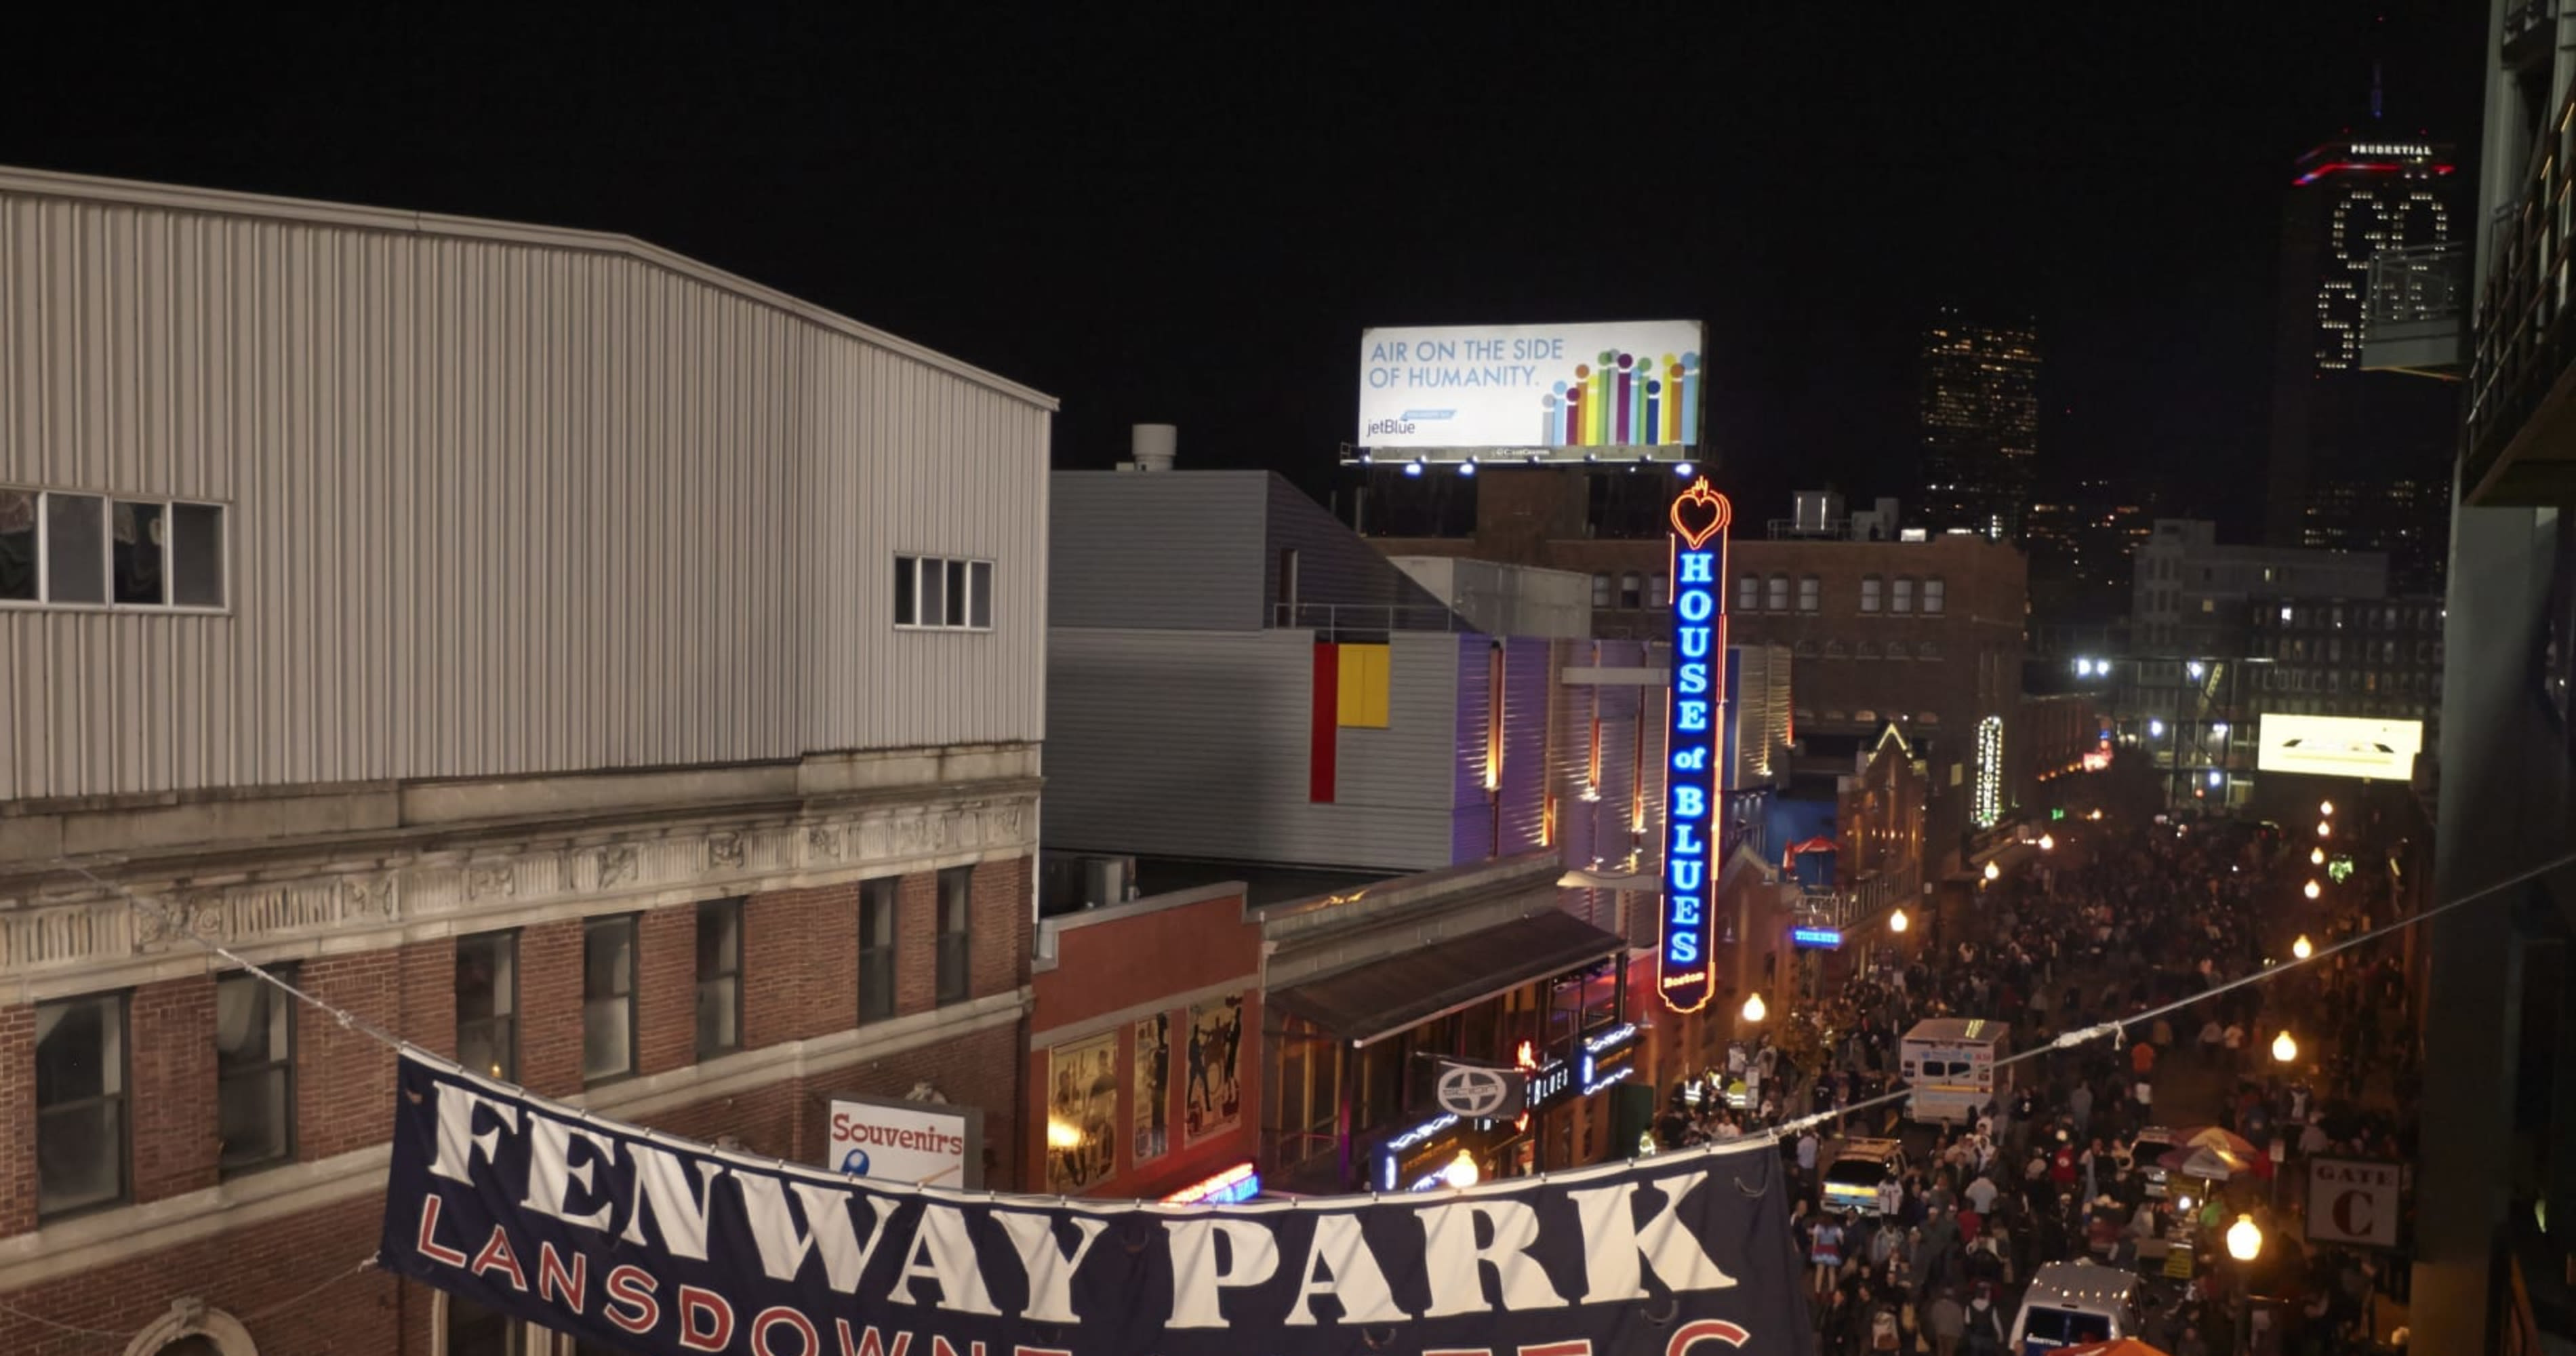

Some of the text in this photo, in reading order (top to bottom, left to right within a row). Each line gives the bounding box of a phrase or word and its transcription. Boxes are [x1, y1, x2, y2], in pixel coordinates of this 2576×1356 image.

[2350, 144, 2432, 155] PRUDENTIAL
[2332, 191, 2448, 270] GO
[1371, 338, 1563, 361] AIR ON THE SIDE
[1369, 365, 1539, 388] OF HUMANITY.
[1366, 418, 1415, 437] jetBlue
[1671, 553, 1713, 963] HOUSE of BLUES
[832, 1113, 963, 1155] Souvenirs
[2316, 1165, 2393, 1186] GATE
[427, 1079, 1738, 1330] FENWAY PARK
[2332, 1189, 2373, 1236] C
